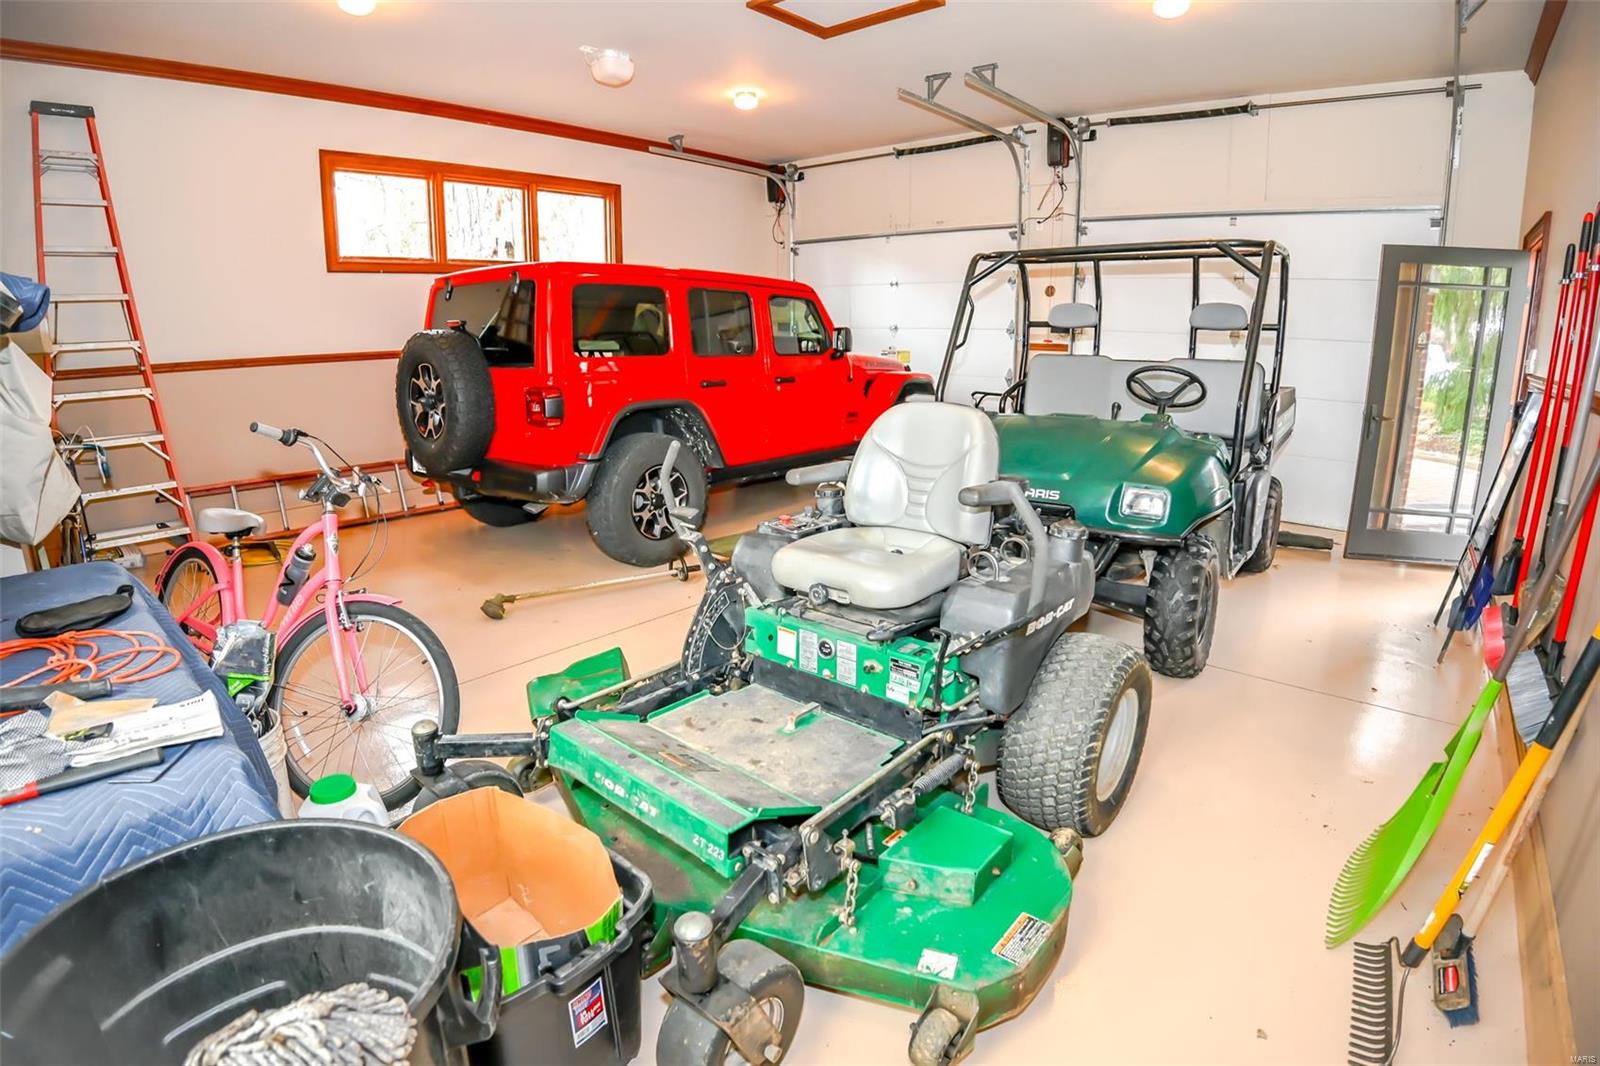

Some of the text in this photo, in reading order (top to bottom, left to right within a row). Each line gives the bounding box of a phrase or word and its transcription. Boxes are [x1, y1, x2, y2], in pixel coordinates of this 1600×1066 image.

[1025, 488, 1060, 500] ARIS
[1025, 598, 1075, 636] BOB-CAT
[692, 833, 725, 861] ZT 223
